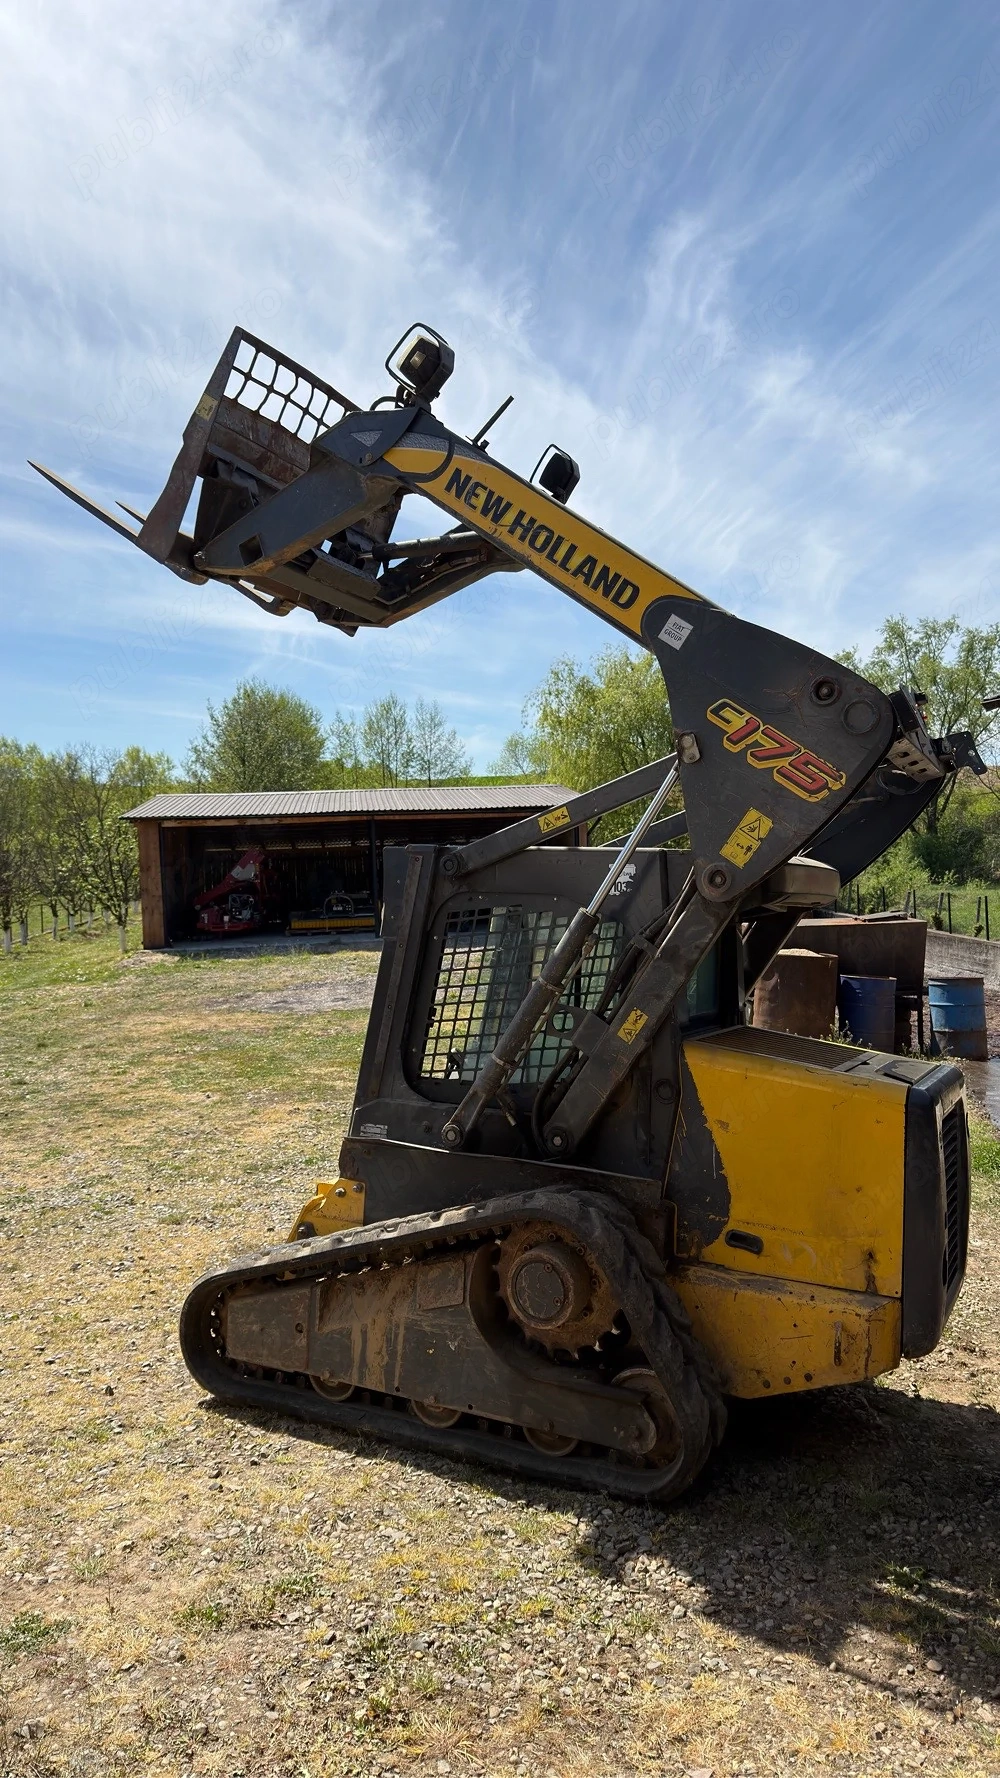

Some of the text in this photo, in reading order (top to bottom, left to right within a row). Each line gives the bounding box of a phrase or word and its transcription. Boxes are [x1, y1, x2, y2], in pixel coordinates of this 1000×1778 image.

[444, 468, 513, 525] NEW
[507, 508, 641, 611] HOLLAND
[672, 621, 685, 633] FIAT
[663, 628, 682, 642] GROUP
